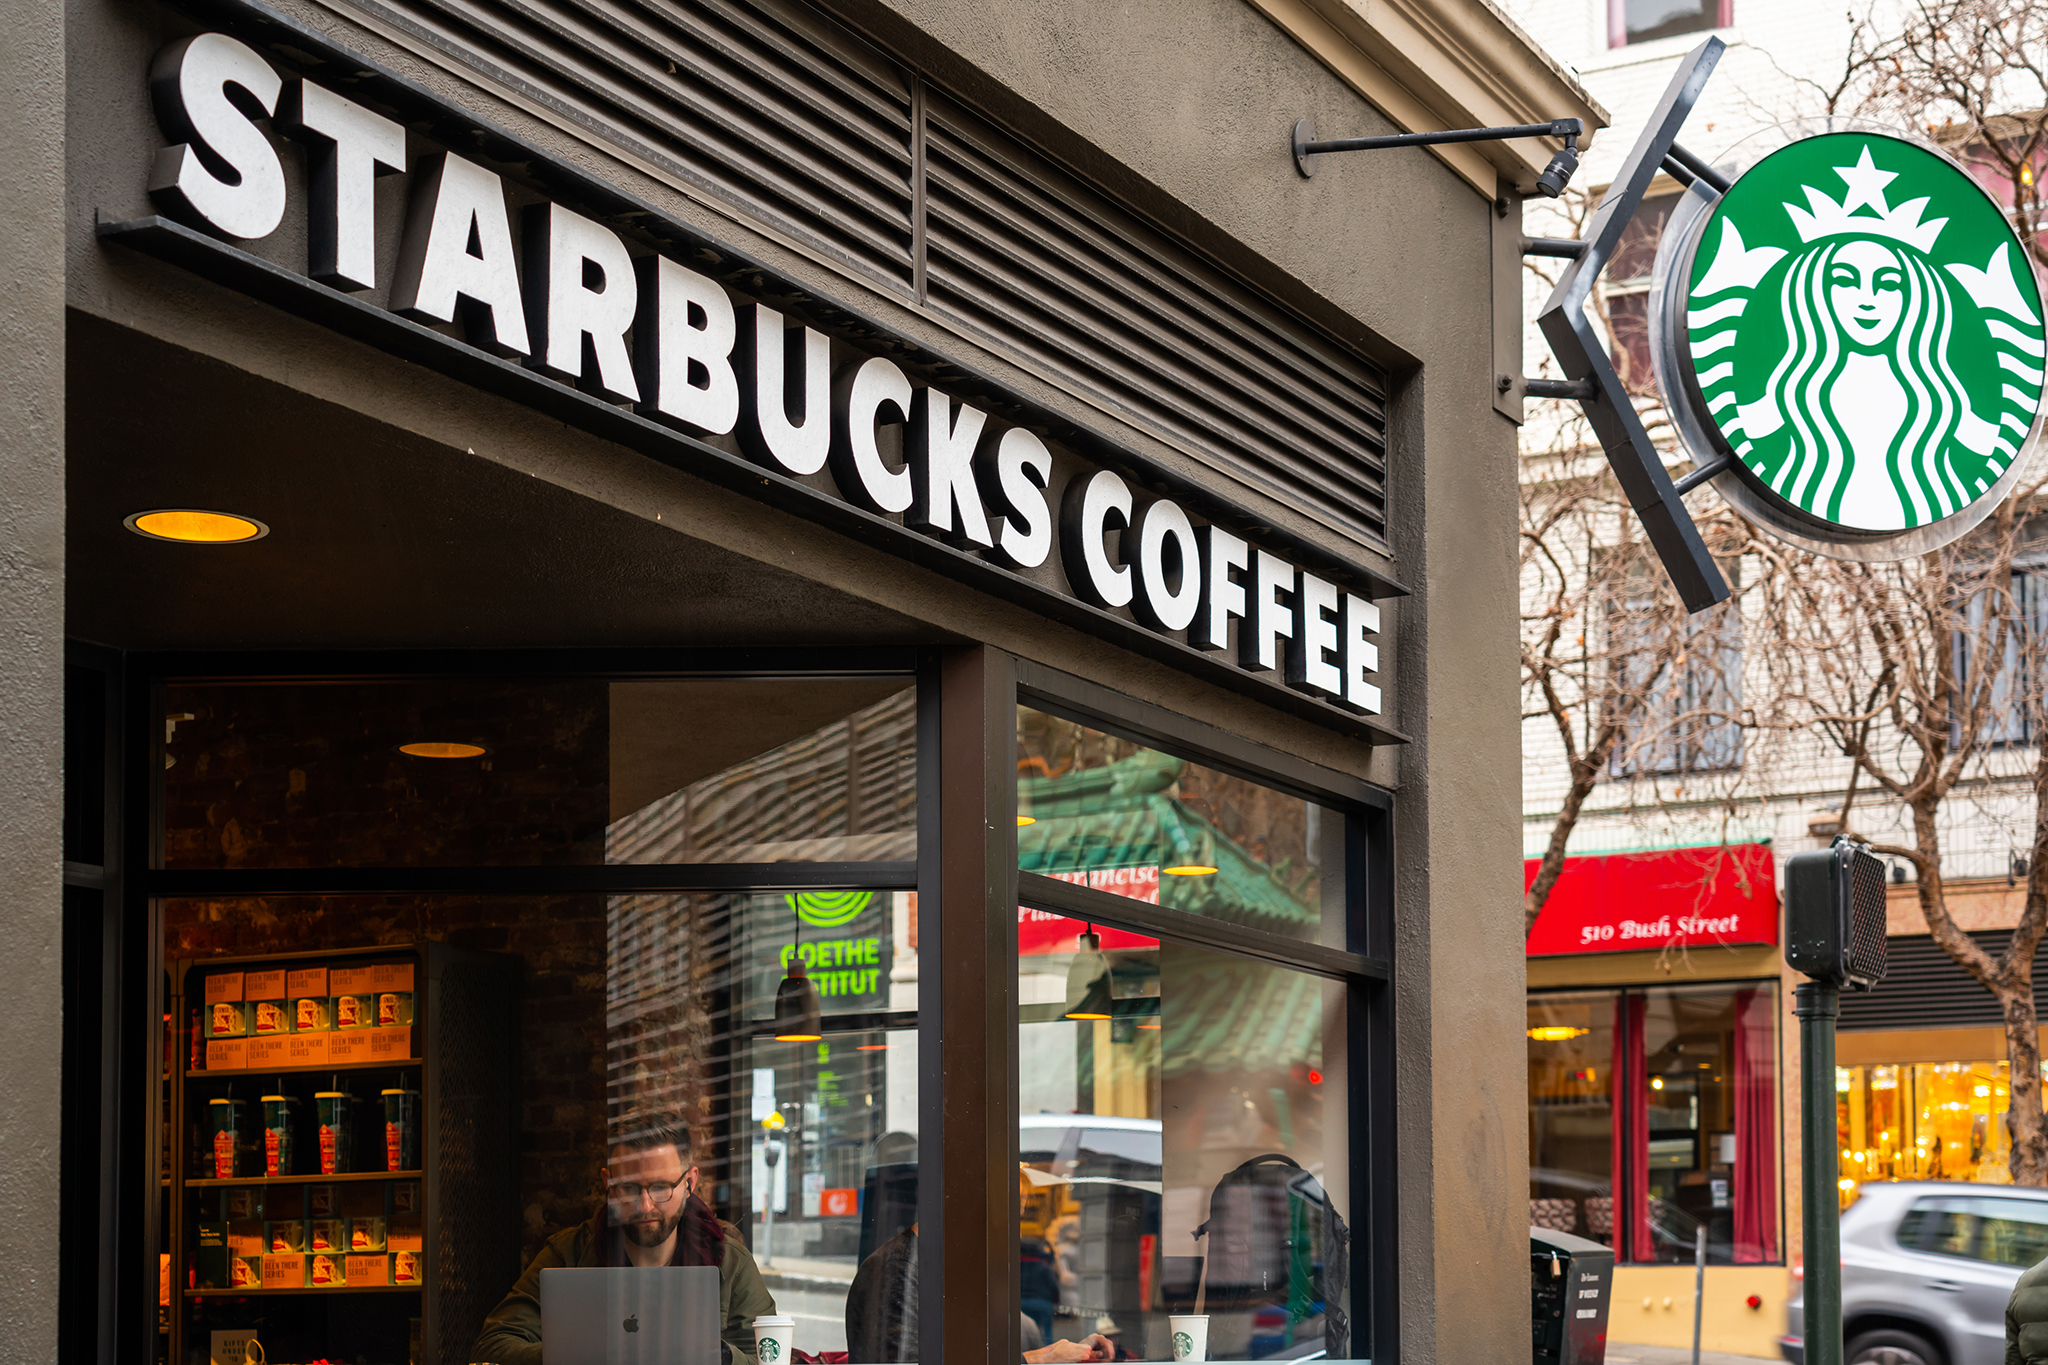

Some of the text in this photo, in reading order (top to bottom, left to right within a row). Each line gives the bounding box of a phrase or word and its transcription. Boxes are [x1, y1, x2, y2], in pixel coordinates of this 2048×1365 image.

[178, 31, 1382, 715] STARBUCKS COFFEE
[1580, 913, 1740, 945] 510 Bush Street
[780, 937, 880, 970] GOETHE
[289, 970, 322, 980] BEEN THERE
[289, 980, 309, 989] SERIES
[290, 1038, 323, 1049] BEEN THERE
[331, 1036, 365, 1047] BEEN THERE
[371, 1034, 405, 1044] BEEN THERE
[208, 1043, 242, 1053] BEEN THERE
[249, 1041, 282, 1051] BEEN THERE
[331, 1046, 352, 1055] SERIES
[371, 1043, 392, 1053] SERIES
[208, 1052, 228, 1062] SERIES
[249, 1050, 269, 1060] SERIES
[290, 1048, 310, 1058] SERIES
[264, 1260, 299, 1270] BEEN THERE
[348, 1258, 383, 1268] BEEN THERE
[264, 1270, 285, 1279] SERIES
[348, 1268, 369, 1277] SERIES
[222, 1347, 247, 1355] UNDER
